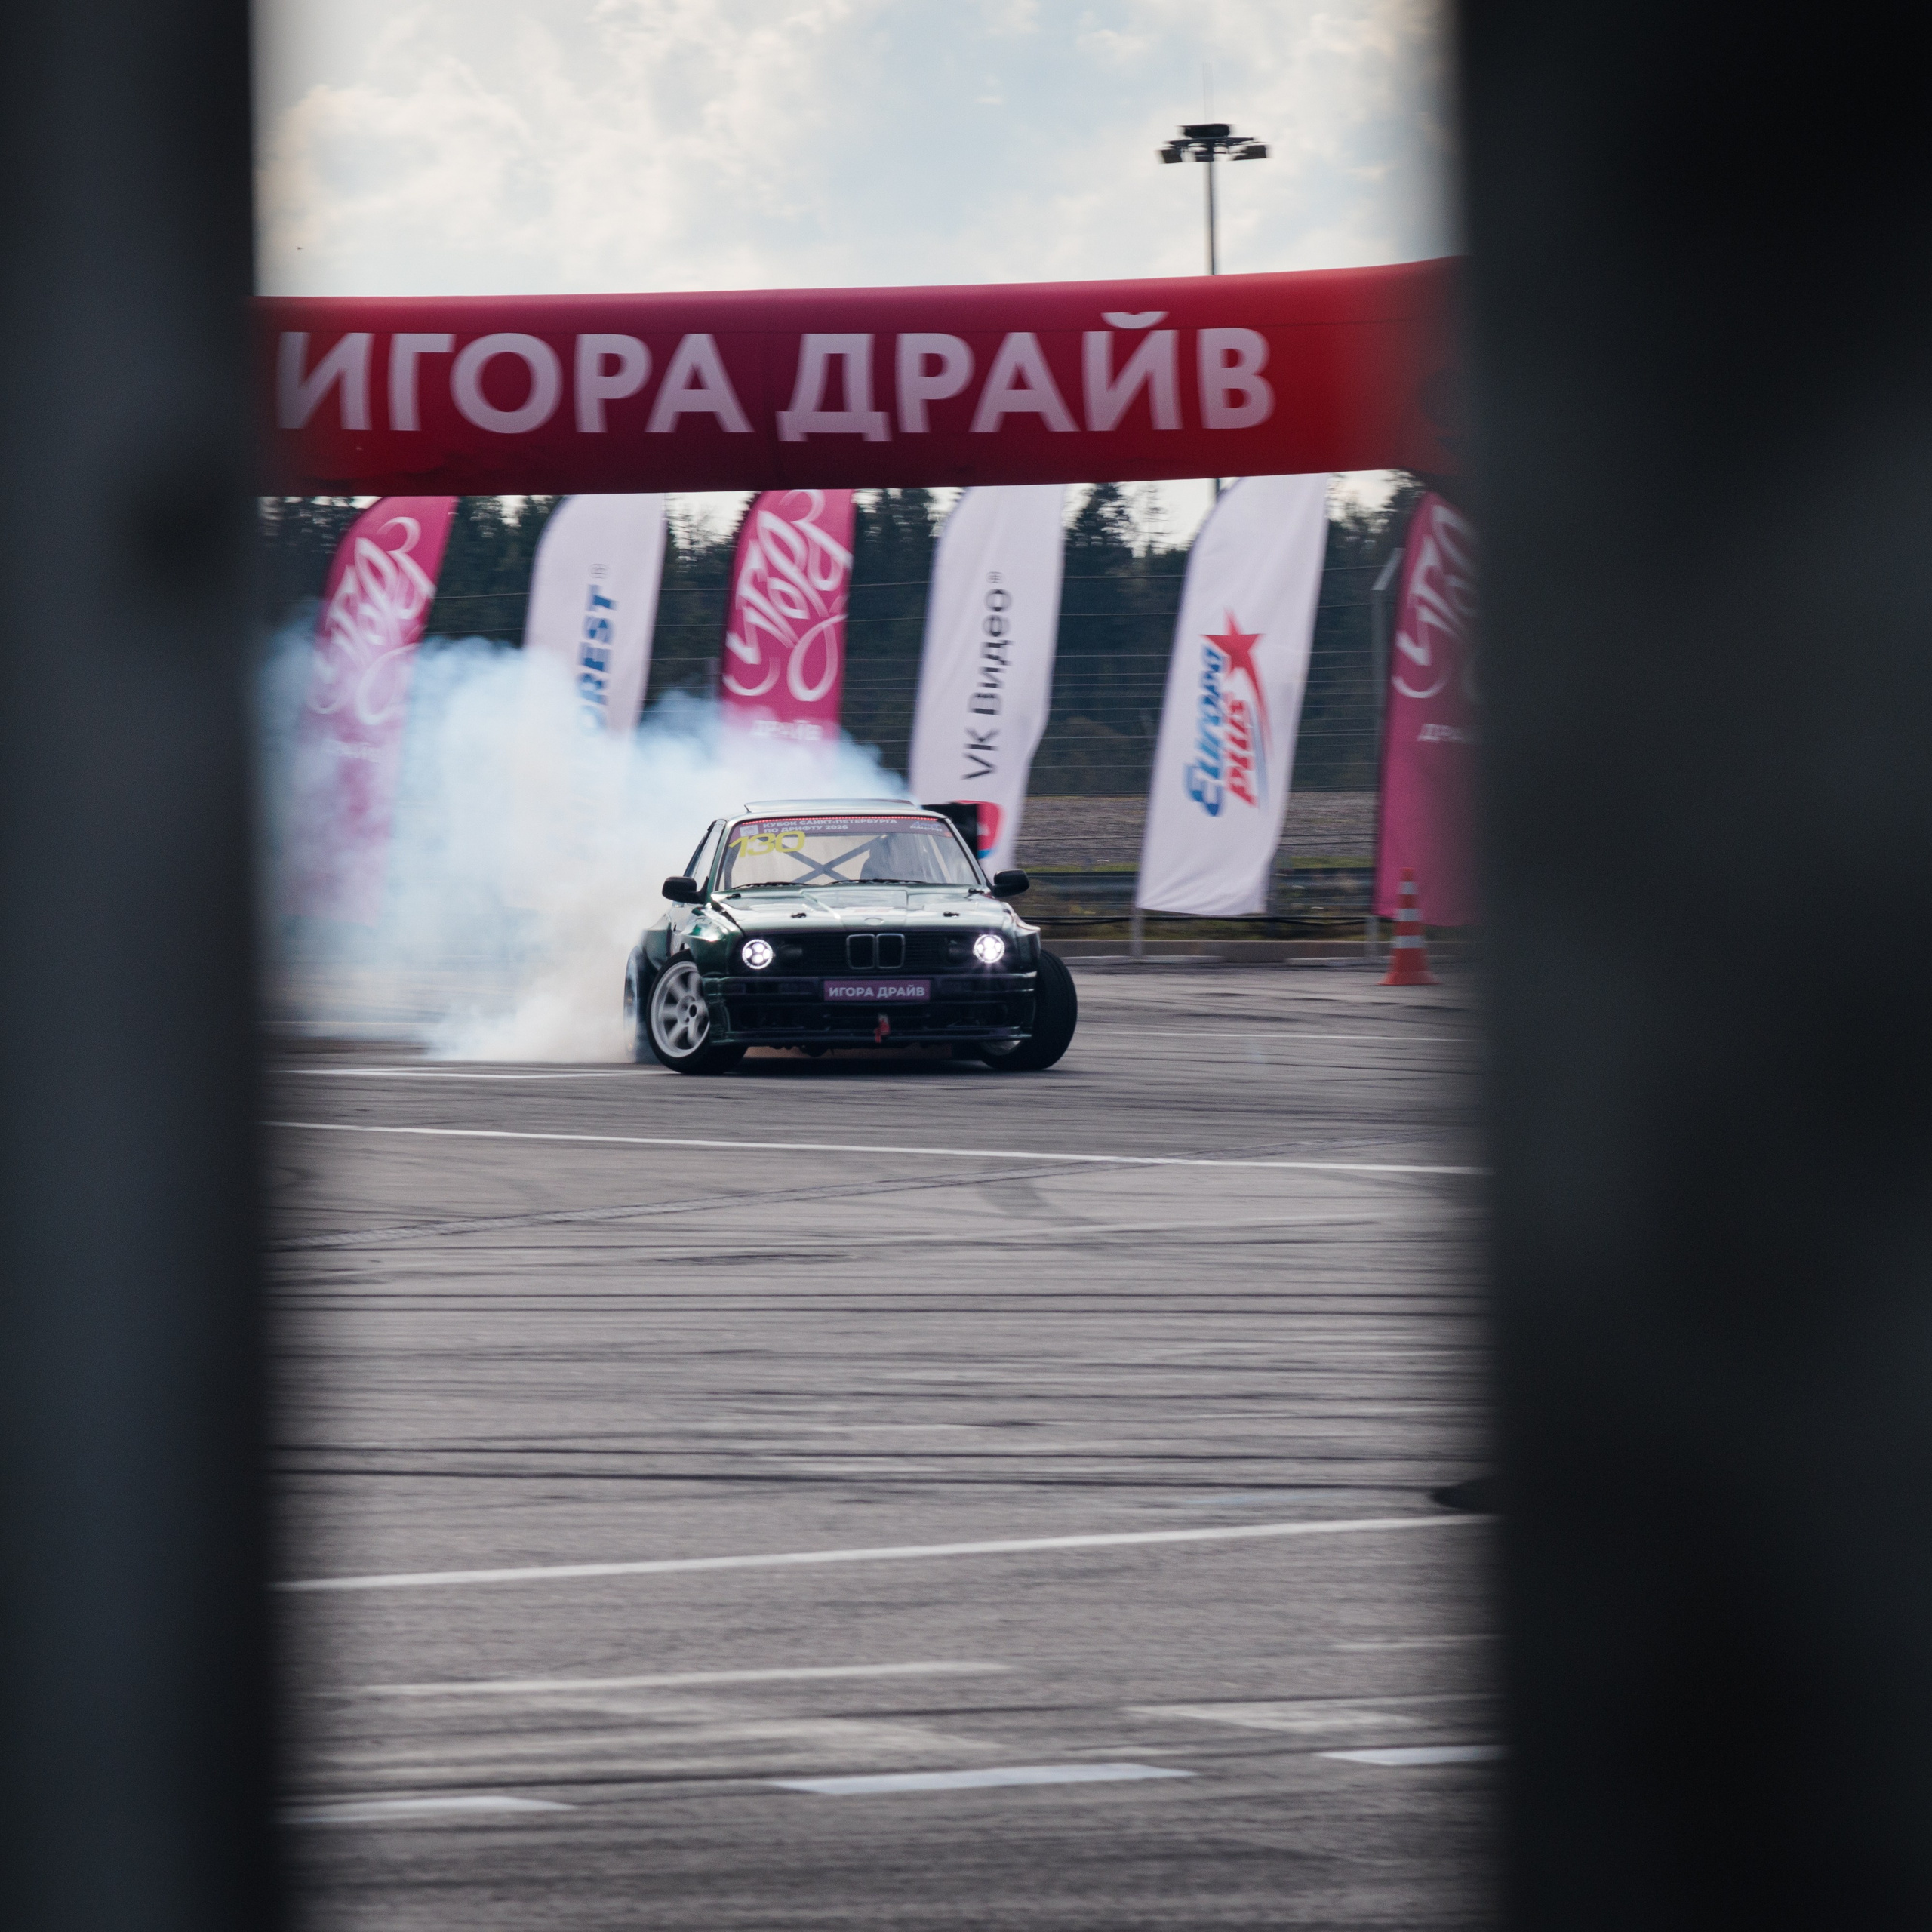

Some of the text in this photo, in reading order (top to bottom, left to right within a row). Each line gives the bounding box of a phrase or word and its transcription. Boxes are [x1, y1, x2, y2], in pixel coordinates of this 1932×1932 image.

[274, 311, 1275, 442] ИГОРА ДРАЙВ
[961, 589, 1014, 780] VK Видео
[728, 831, 806, 858] 130
[829, 984, 925, 998] ИГОРА ДРАЙВ
